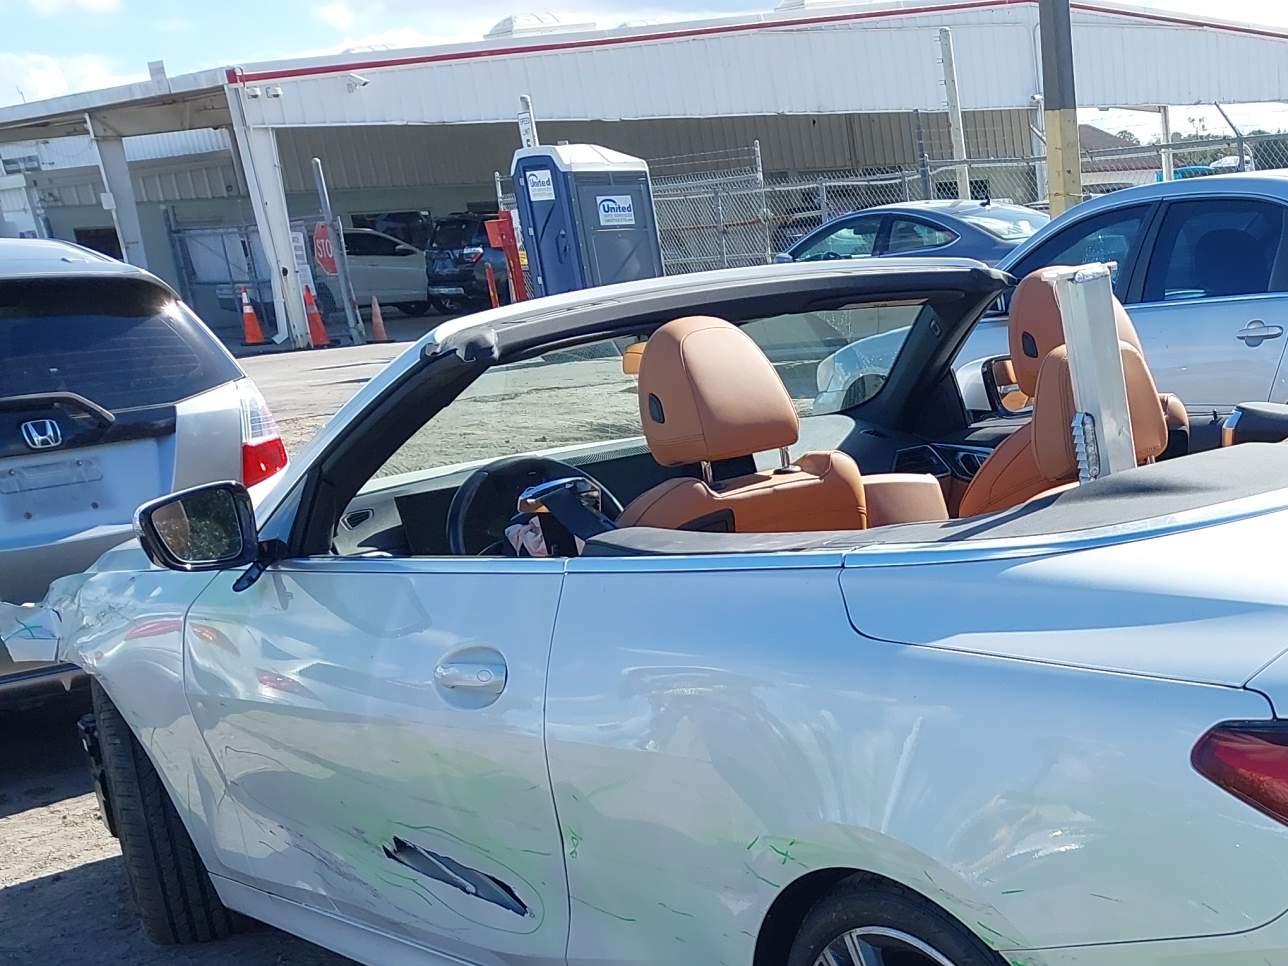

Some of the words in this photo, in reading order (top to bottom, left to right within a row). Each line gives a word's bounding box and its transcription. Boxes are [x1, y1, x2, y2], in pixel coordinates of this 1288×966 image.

[529, 177, 551, 188] United
[602, 203, 632, 213] United
[316, 239, 334, 258] STO
